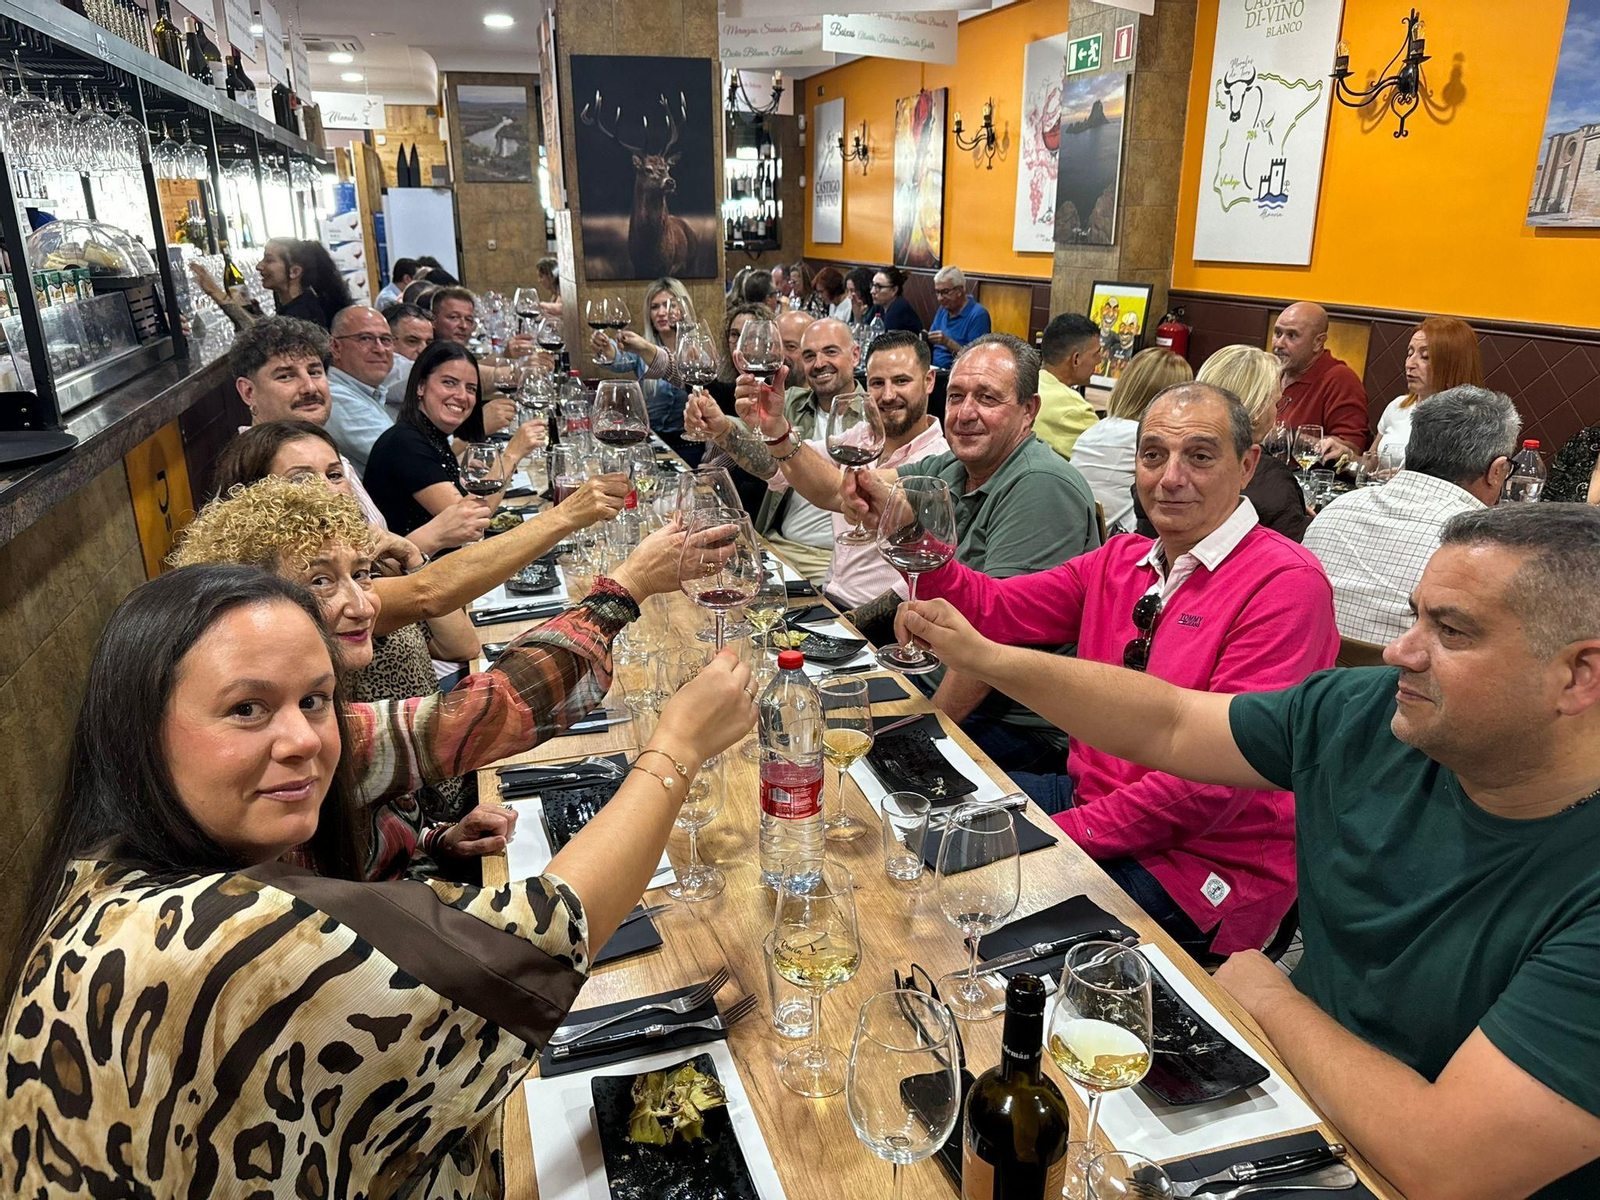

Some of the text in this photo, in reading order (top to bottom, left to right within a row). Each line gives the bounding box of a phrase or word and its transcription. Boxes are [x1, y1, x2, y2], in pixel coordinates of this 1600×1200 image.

[1245, 0, 1304, 29] DI-VINO
[1266, 20, 1303, 38] BLANCO
[815, 179, 840, 194] CASTIGO
[1181, 613, 1203, 624] TOMMY
